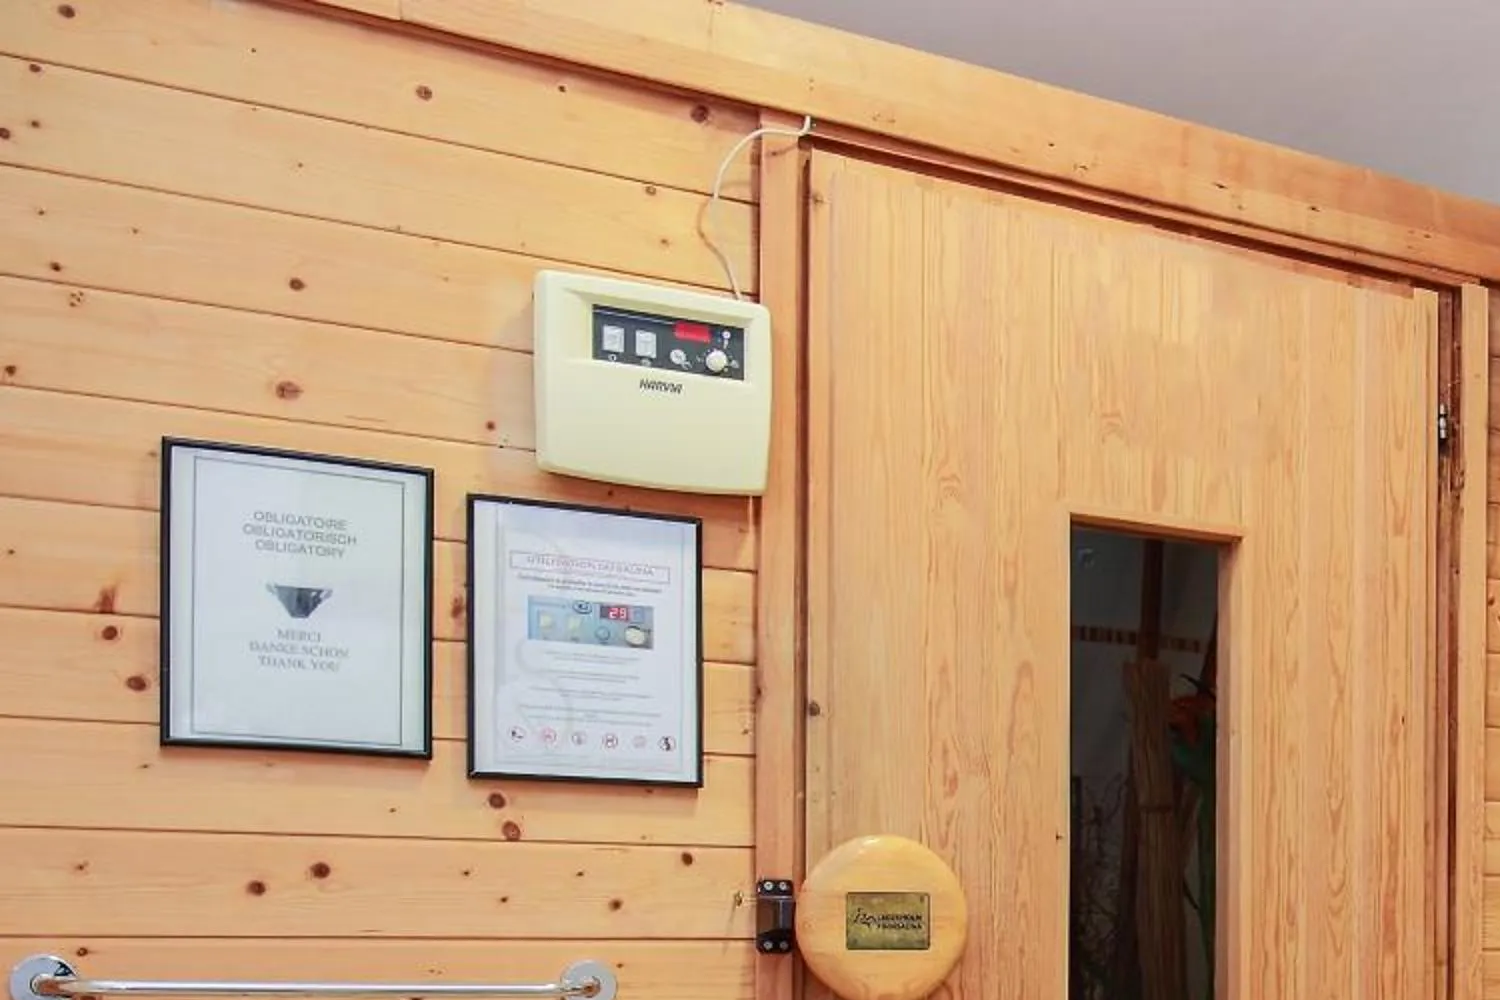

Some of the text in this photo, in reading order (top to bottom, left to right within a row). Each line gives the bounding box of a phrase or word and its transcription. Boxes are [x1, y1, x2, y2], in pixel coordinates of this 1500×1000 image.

[253, 511, 348, 531] OBLIGATOIRE
[241, 522, 357, 545] OBLIGATORISCH
[254, 538, 345, 559] OBLIGATORY
[276, 627, 322, 643] MERCI
[257, 654, 341, 673] THANK YOU
